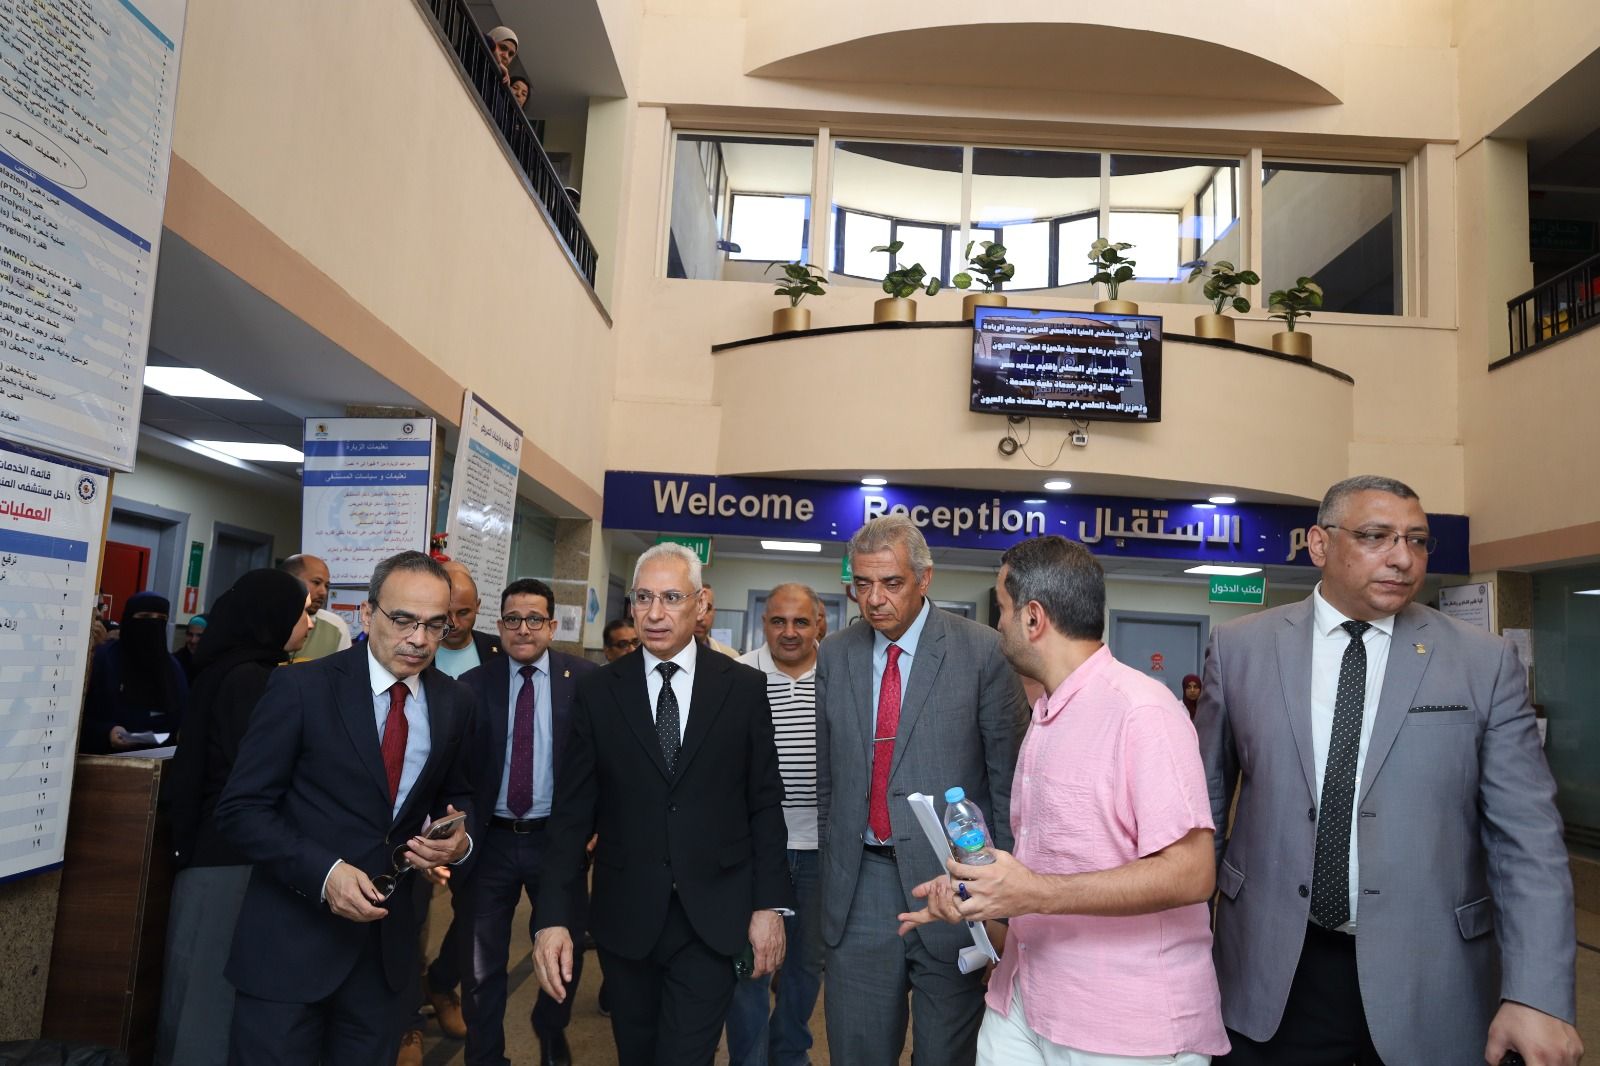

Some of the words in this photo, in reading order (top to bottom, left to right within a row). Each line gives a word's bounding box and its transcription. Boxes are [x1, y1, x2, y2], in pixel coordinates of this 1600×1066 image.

[1066, 345, 1086, 354] صحية
[1088, 346, 1106, 356] رعاية
[1107, 348, 1129, 357] تقديم
[1009, 378, 1035, 386] متقدمة
[1036, 379, 1052, 388] طبية
[1054, 380, 1076, 389] خدمات
[1077, 382, 1096, 392] توفير
[1097, 383, 1114, 392] خلال
[1115, 384, 1124, 393] من
[1047, 400, 1066, 408] جميع
[1106, 401, 1124, 411] البحث
[30, 467, 51, 480] قائمة
[0, 476, 16, 488] المن
[18, 482, 52, 496] مستشفى
[54, 490, 71, 500] داخل
[654, 480, 814, 522] Welcome
[0, 500, 52, 522] العمليات
[864, 496, 1046, 536] Reception
[1079, 508, 1240, 548] الاستقبال
[1212, 583, 1239, 594] الدخول
[1241, 585, 1261, 596] مكتب
